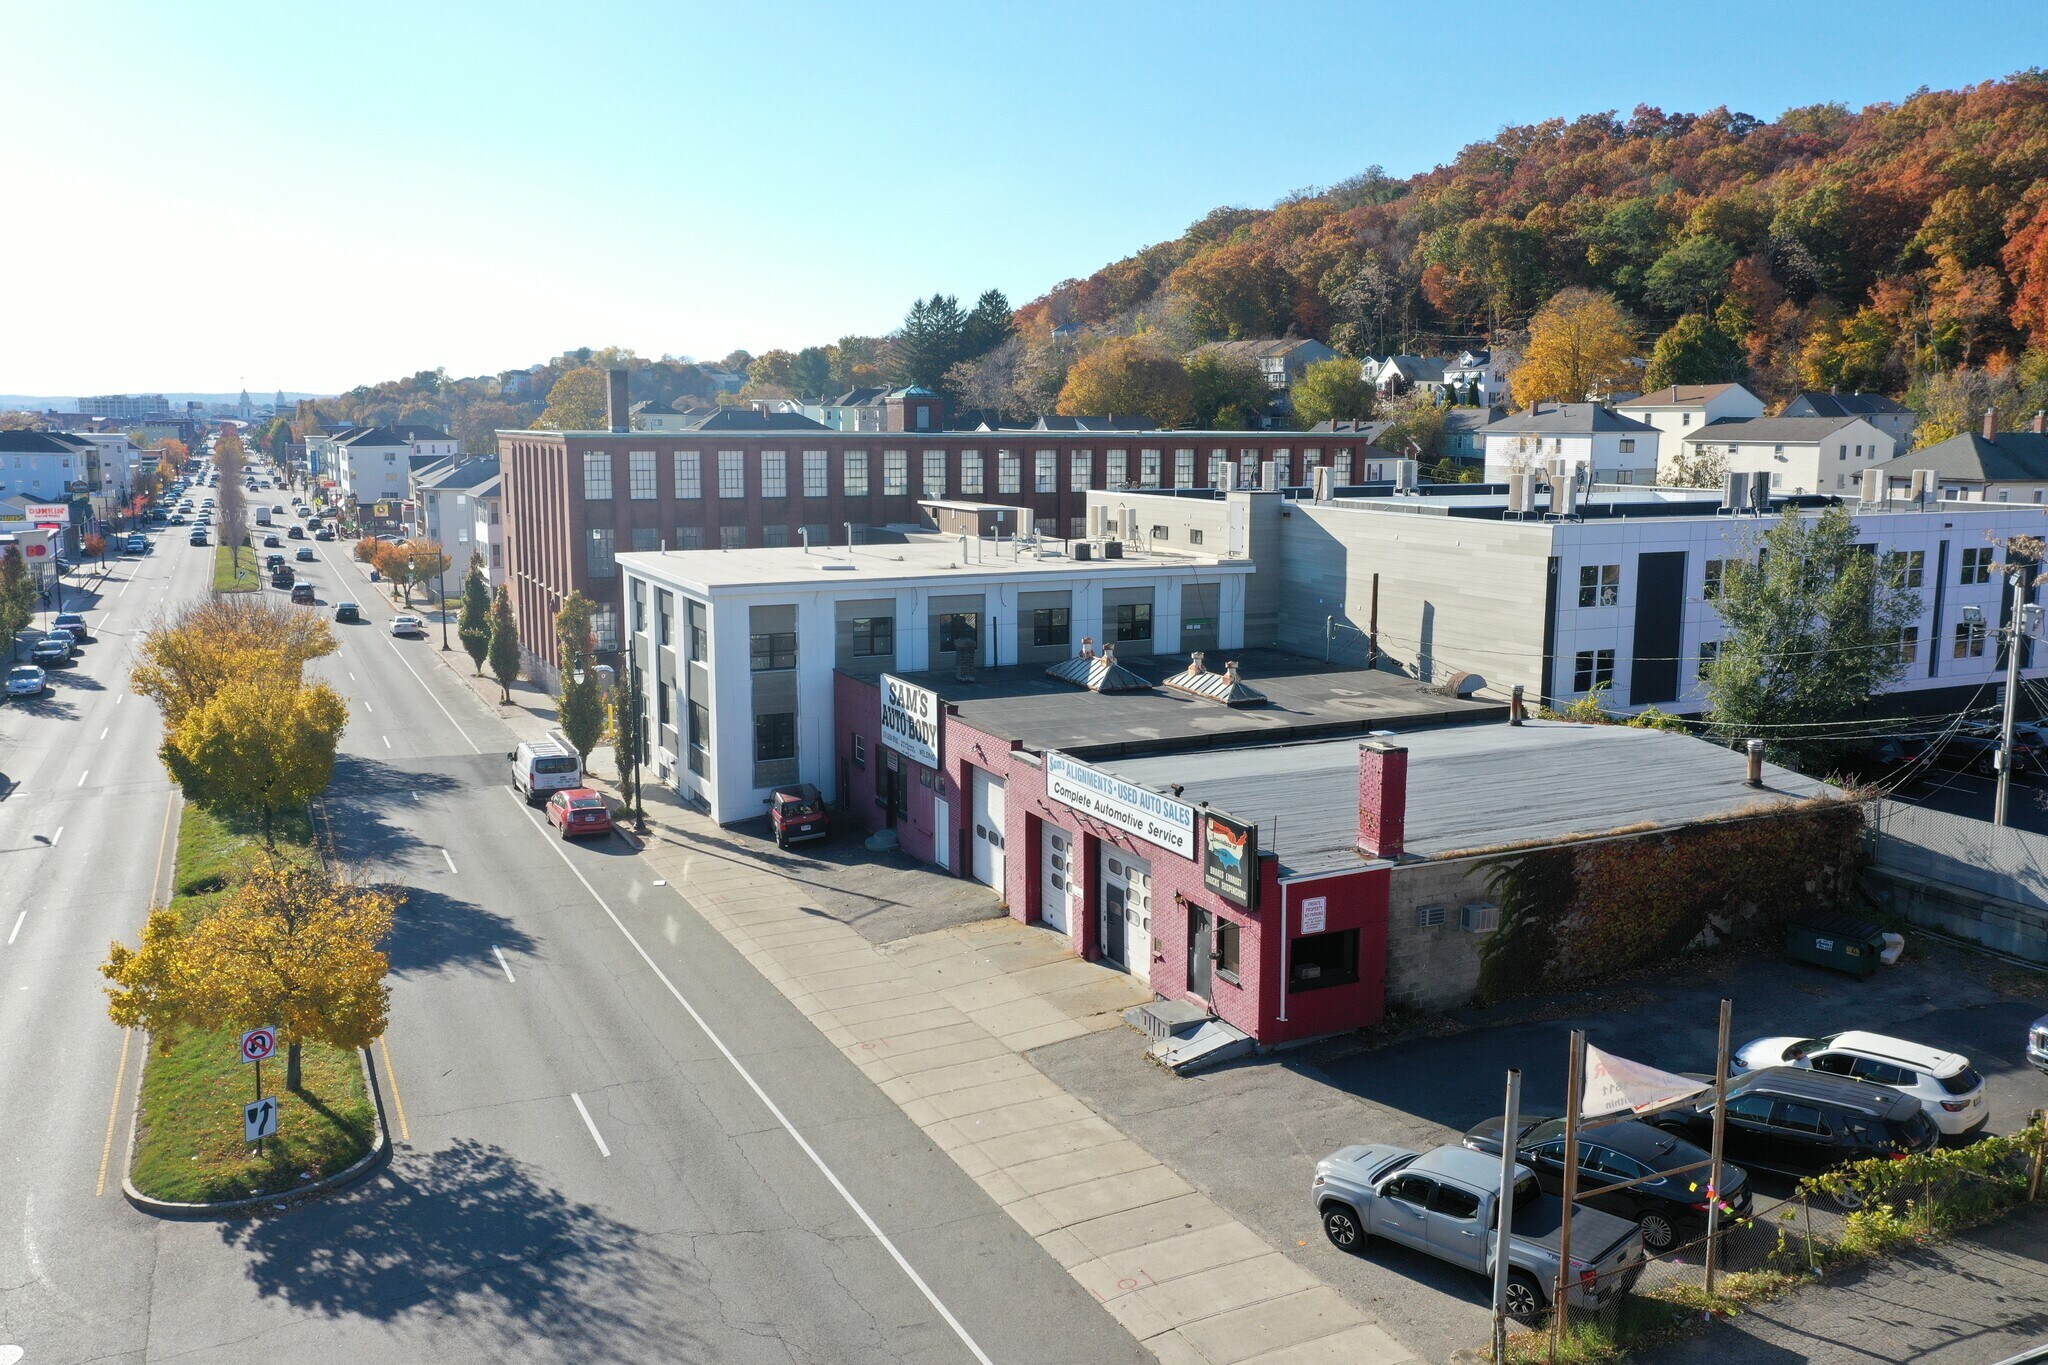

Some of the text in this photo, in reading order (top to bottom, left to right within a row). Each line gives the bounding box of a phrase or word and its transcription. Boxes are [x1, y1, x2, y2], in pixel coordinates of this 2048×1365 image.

[888, 682, 928, 718] SAM'S
[882, 703, 907, 736] AUTO
[908, 714, 937, 748] BODY
[1049, 756, 1191, 826] Sam's ALIGNMENTS USED AUTO SALES
[1053, 782, 1184, 847] Complete Automotive Service
[1206, 874, 1247, 900] SHOCKS SUSPENSIONS
[1225, 872, 1242, 888] EXHAUST
